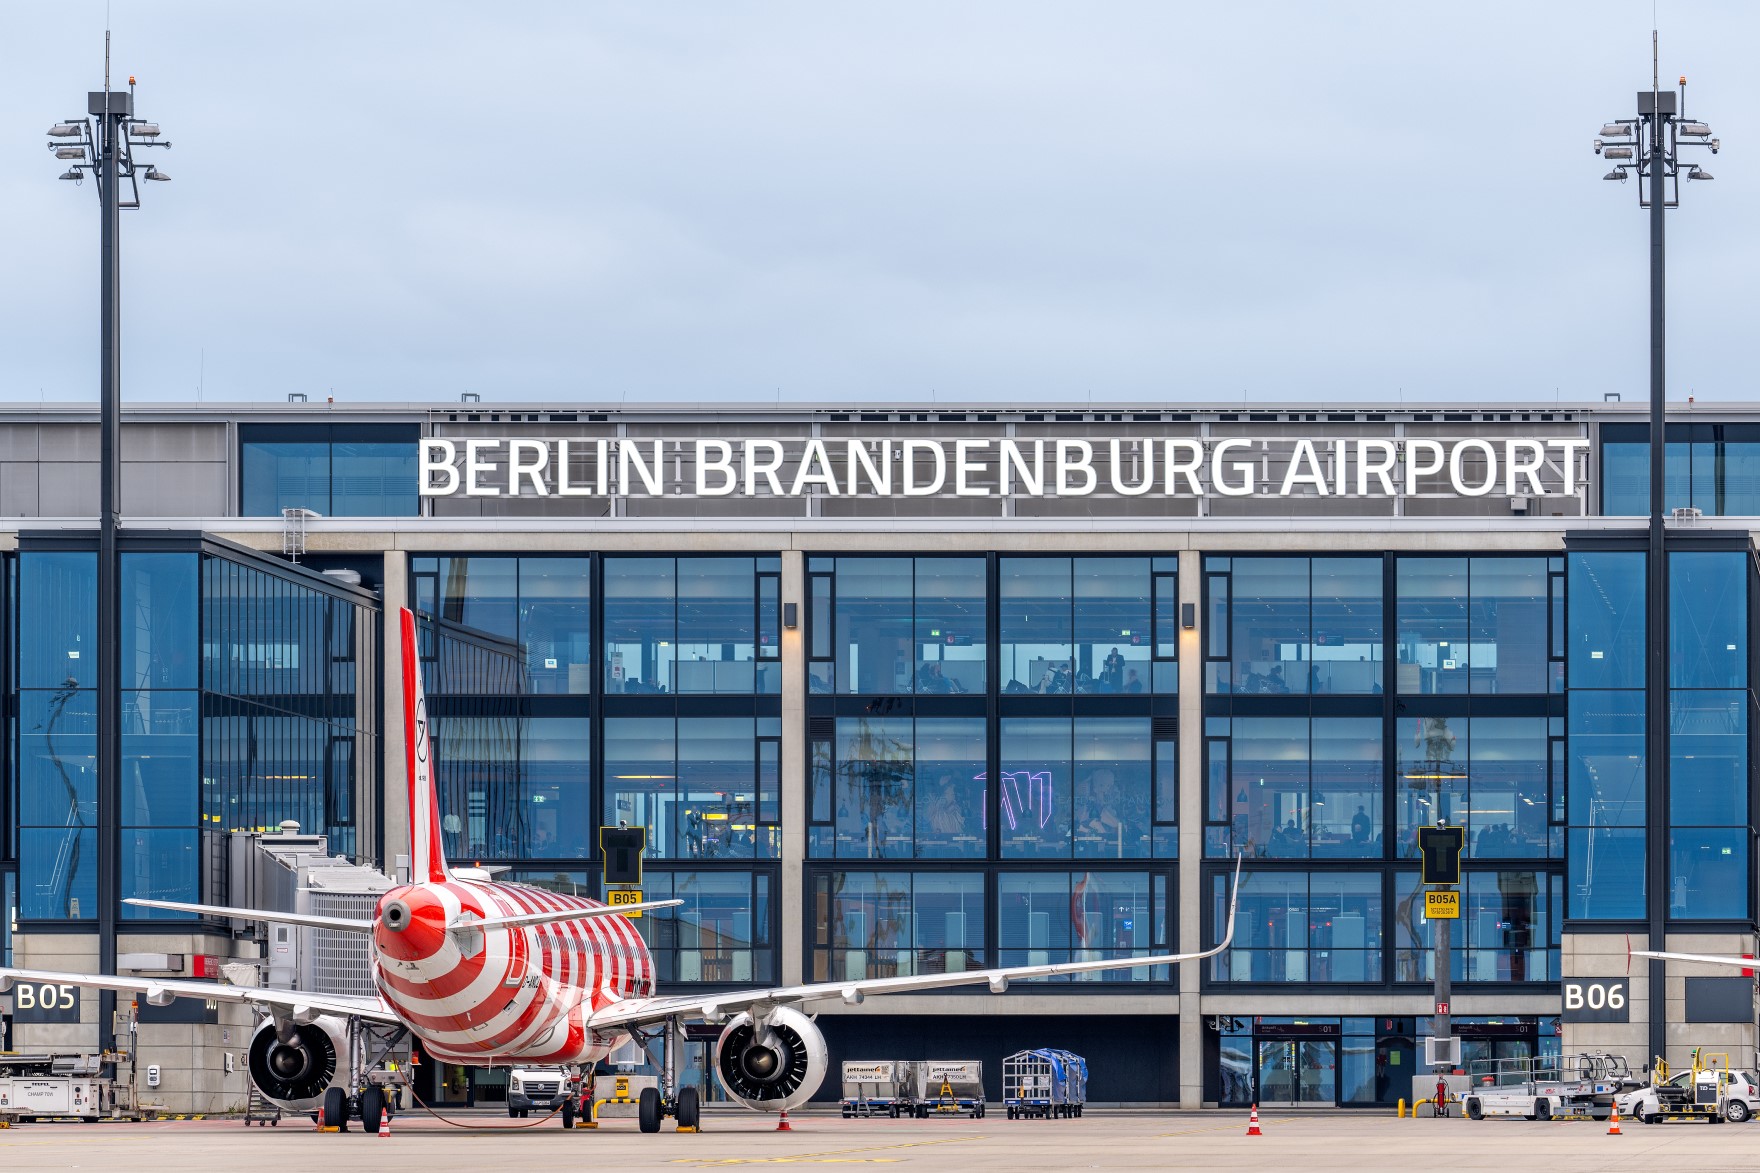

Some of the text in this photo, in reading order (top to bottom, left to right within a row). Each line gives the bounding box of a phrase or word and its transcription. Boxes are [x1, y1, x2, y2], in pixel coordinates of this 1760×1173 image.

[418, 438, 1591, 497] BERLIN BRANDENBURG AIRPORT
[614, 893, 637, 904] B05
[1428, 894, 1456, 904] B05A
[17, 984, 75, 1009] B05
[1565, 983, 1625, 1010] B06
